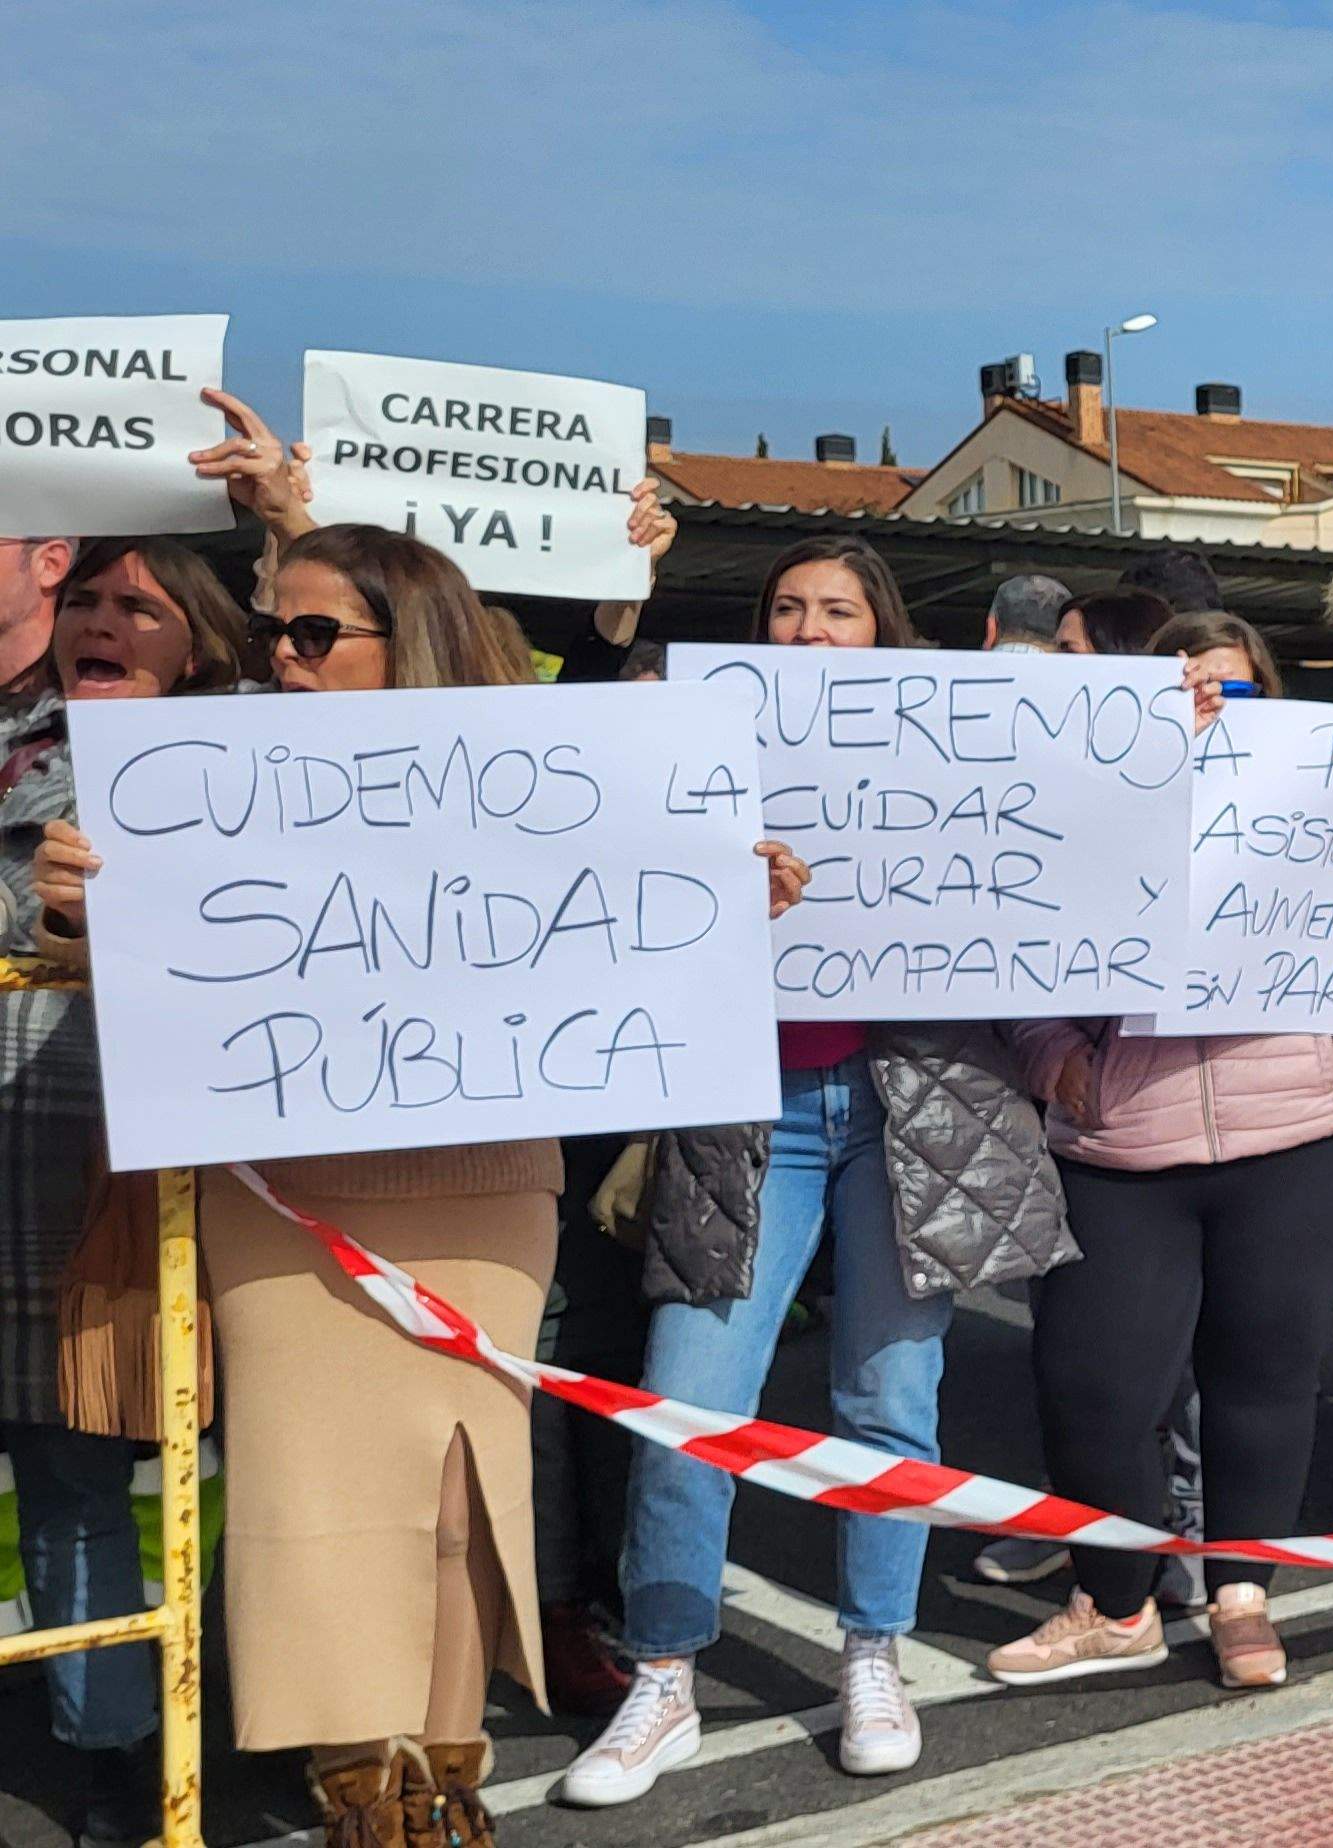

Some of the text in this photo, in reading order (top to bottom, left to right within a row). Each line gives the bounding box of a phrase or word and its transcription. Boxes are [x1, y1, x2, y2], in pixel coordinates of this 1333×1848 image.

[381, 393, 593, 443] CARRERA
[334, 439, 632, 495] PROFESIONAL
[110, 736, 749, 836] CUIDEMOS LA
[762, 780, 1063, 840] CUIDAR
[803, 851, 1061, 911] CURAR
[168, 868, 718, 983] SANIDAD
[208, 1002, 687, 1118] PÚBLICA
